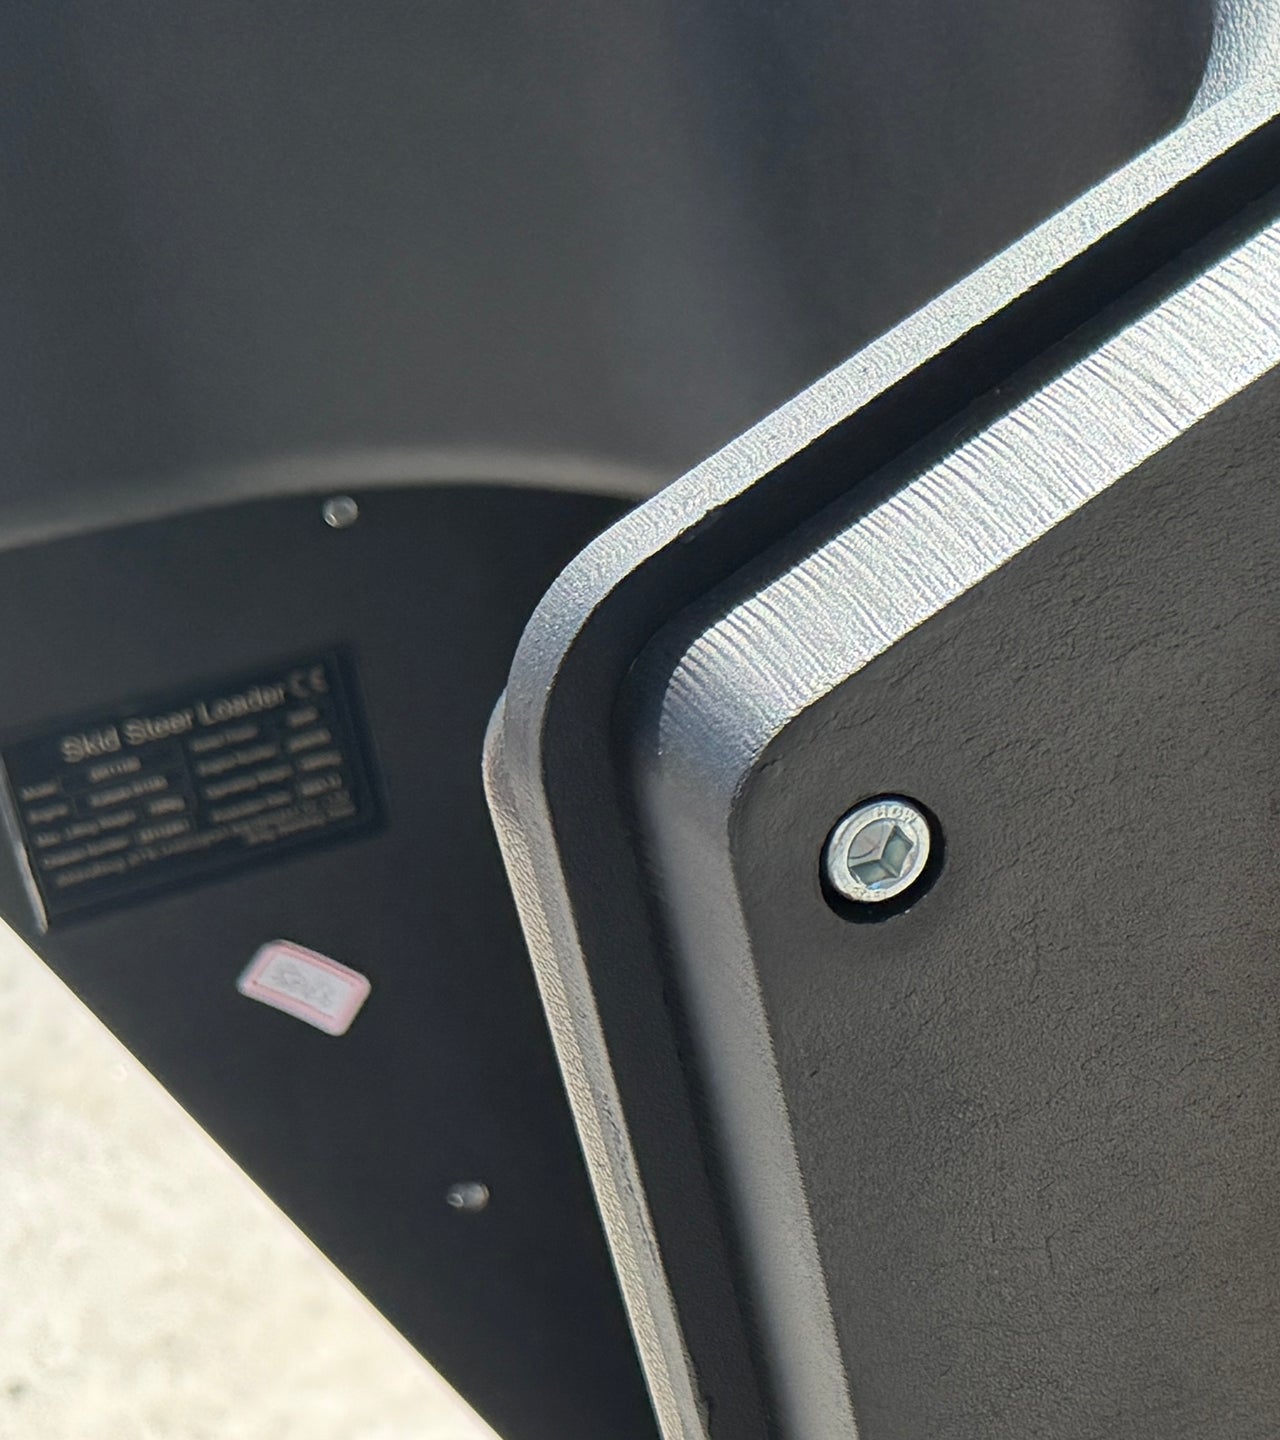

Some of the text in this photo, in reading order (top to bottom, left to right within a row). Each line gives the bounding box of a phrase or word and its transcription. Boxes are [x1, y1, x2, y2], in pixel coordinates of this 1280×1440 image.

[60, 724, 122, 764] Skid
[123, 705, 196, 746] Steer
[196, 682, 287, 726] Loader
